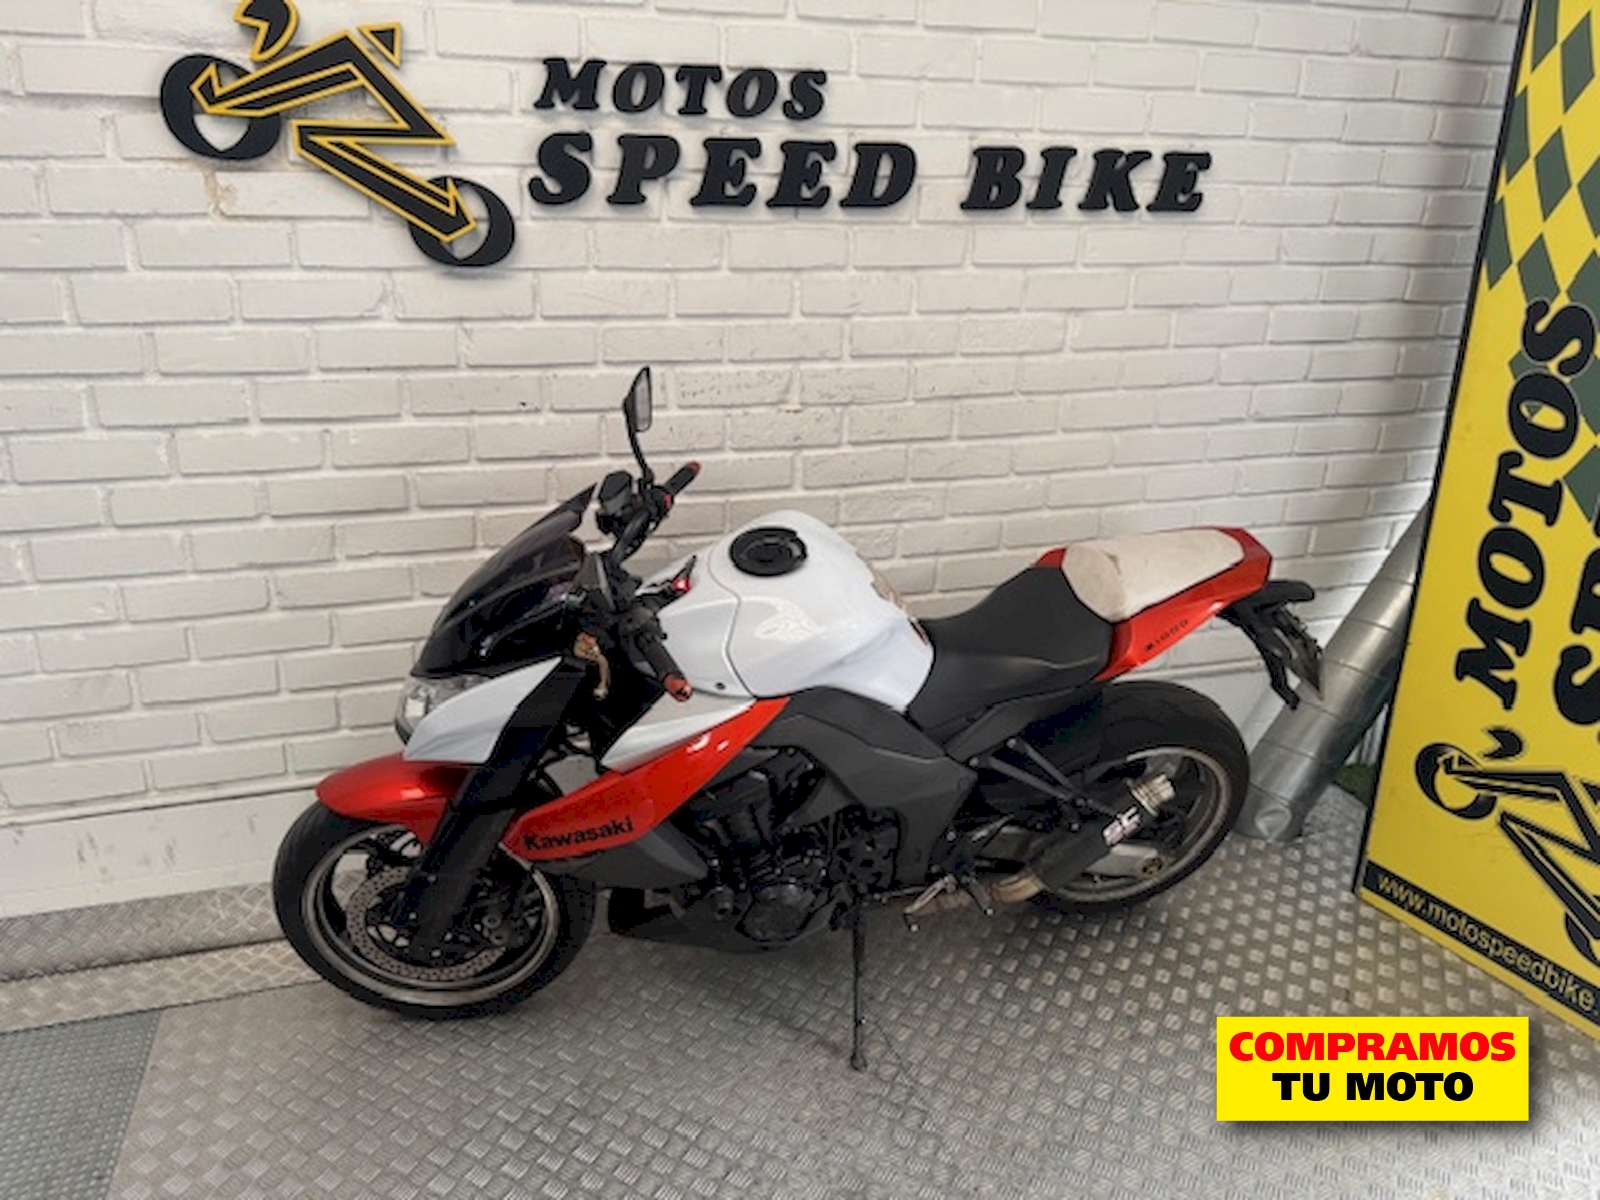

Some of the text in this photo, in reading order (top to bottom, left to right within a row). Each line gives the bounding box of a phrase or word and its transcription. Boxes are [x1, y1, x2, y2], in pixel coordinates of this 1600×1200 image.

[534, 57, 827, 119] MOTOS
[528, 132, 1212, 212] SPEED BIKE
[1454, 297, 1597, 712] MOTOS
[524, 815, 634, 850] Kawasaki
